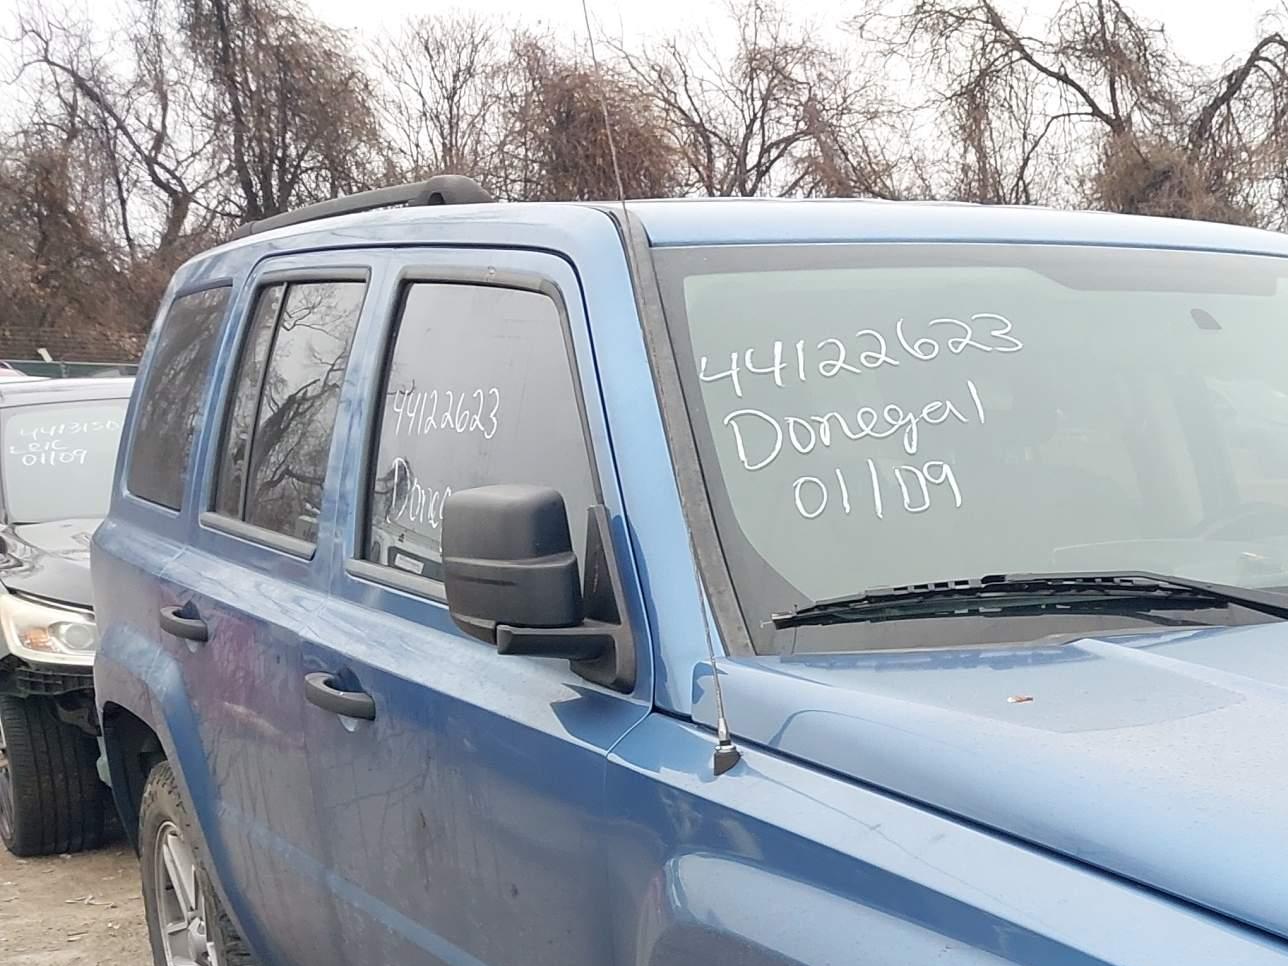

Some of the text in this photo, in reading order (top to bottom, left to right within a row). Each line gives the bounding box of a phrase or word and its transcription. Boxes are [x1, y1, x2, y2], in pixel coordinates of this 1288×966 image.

[699, 313, 1024, 398] 44122623
[392, 387, 500, 440] 44122623
[723, 380, 986, 471] Donegal
